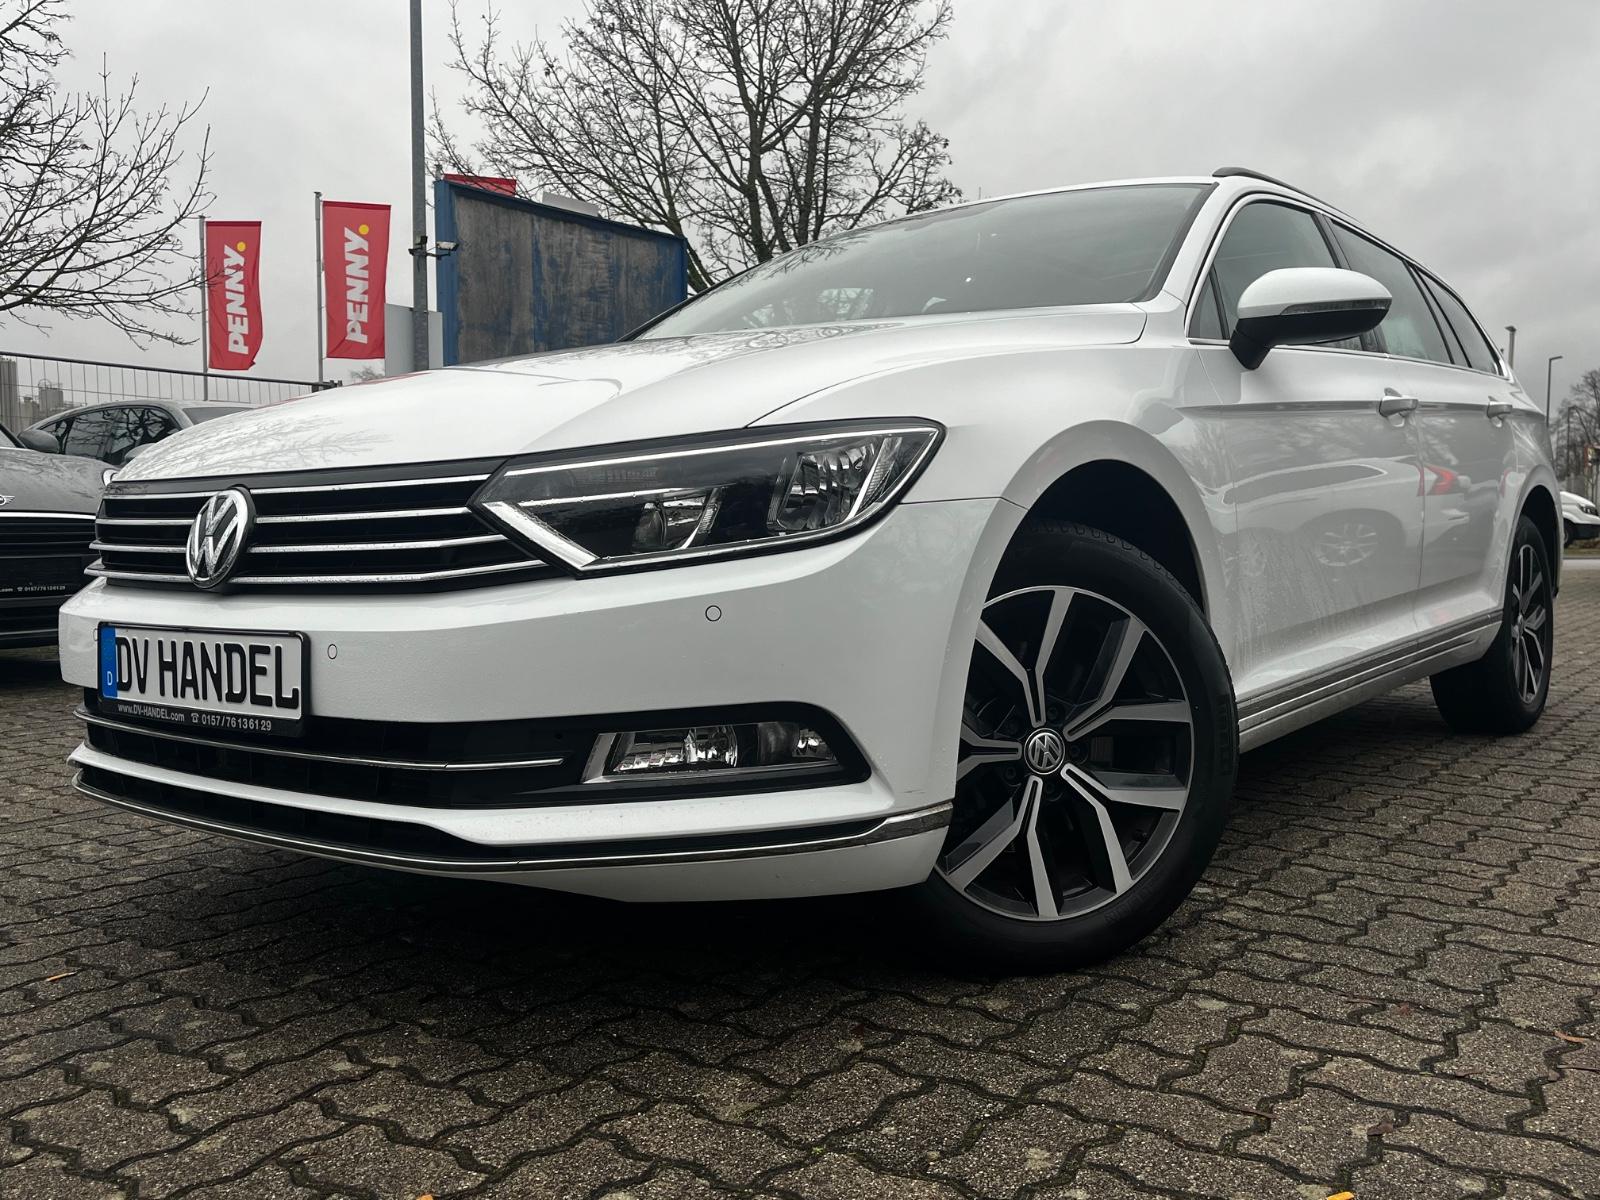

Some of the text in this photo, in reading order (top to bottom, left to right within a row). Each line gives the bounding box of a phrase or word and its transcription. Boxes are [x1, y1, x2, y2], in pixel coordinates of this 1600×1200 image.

[106, 671, 113, 686] D
[115, 636, 299, 709] DV HANDEL
[117, 703, 272, 731] www.DV-HANDEL.com 0157/76136129
